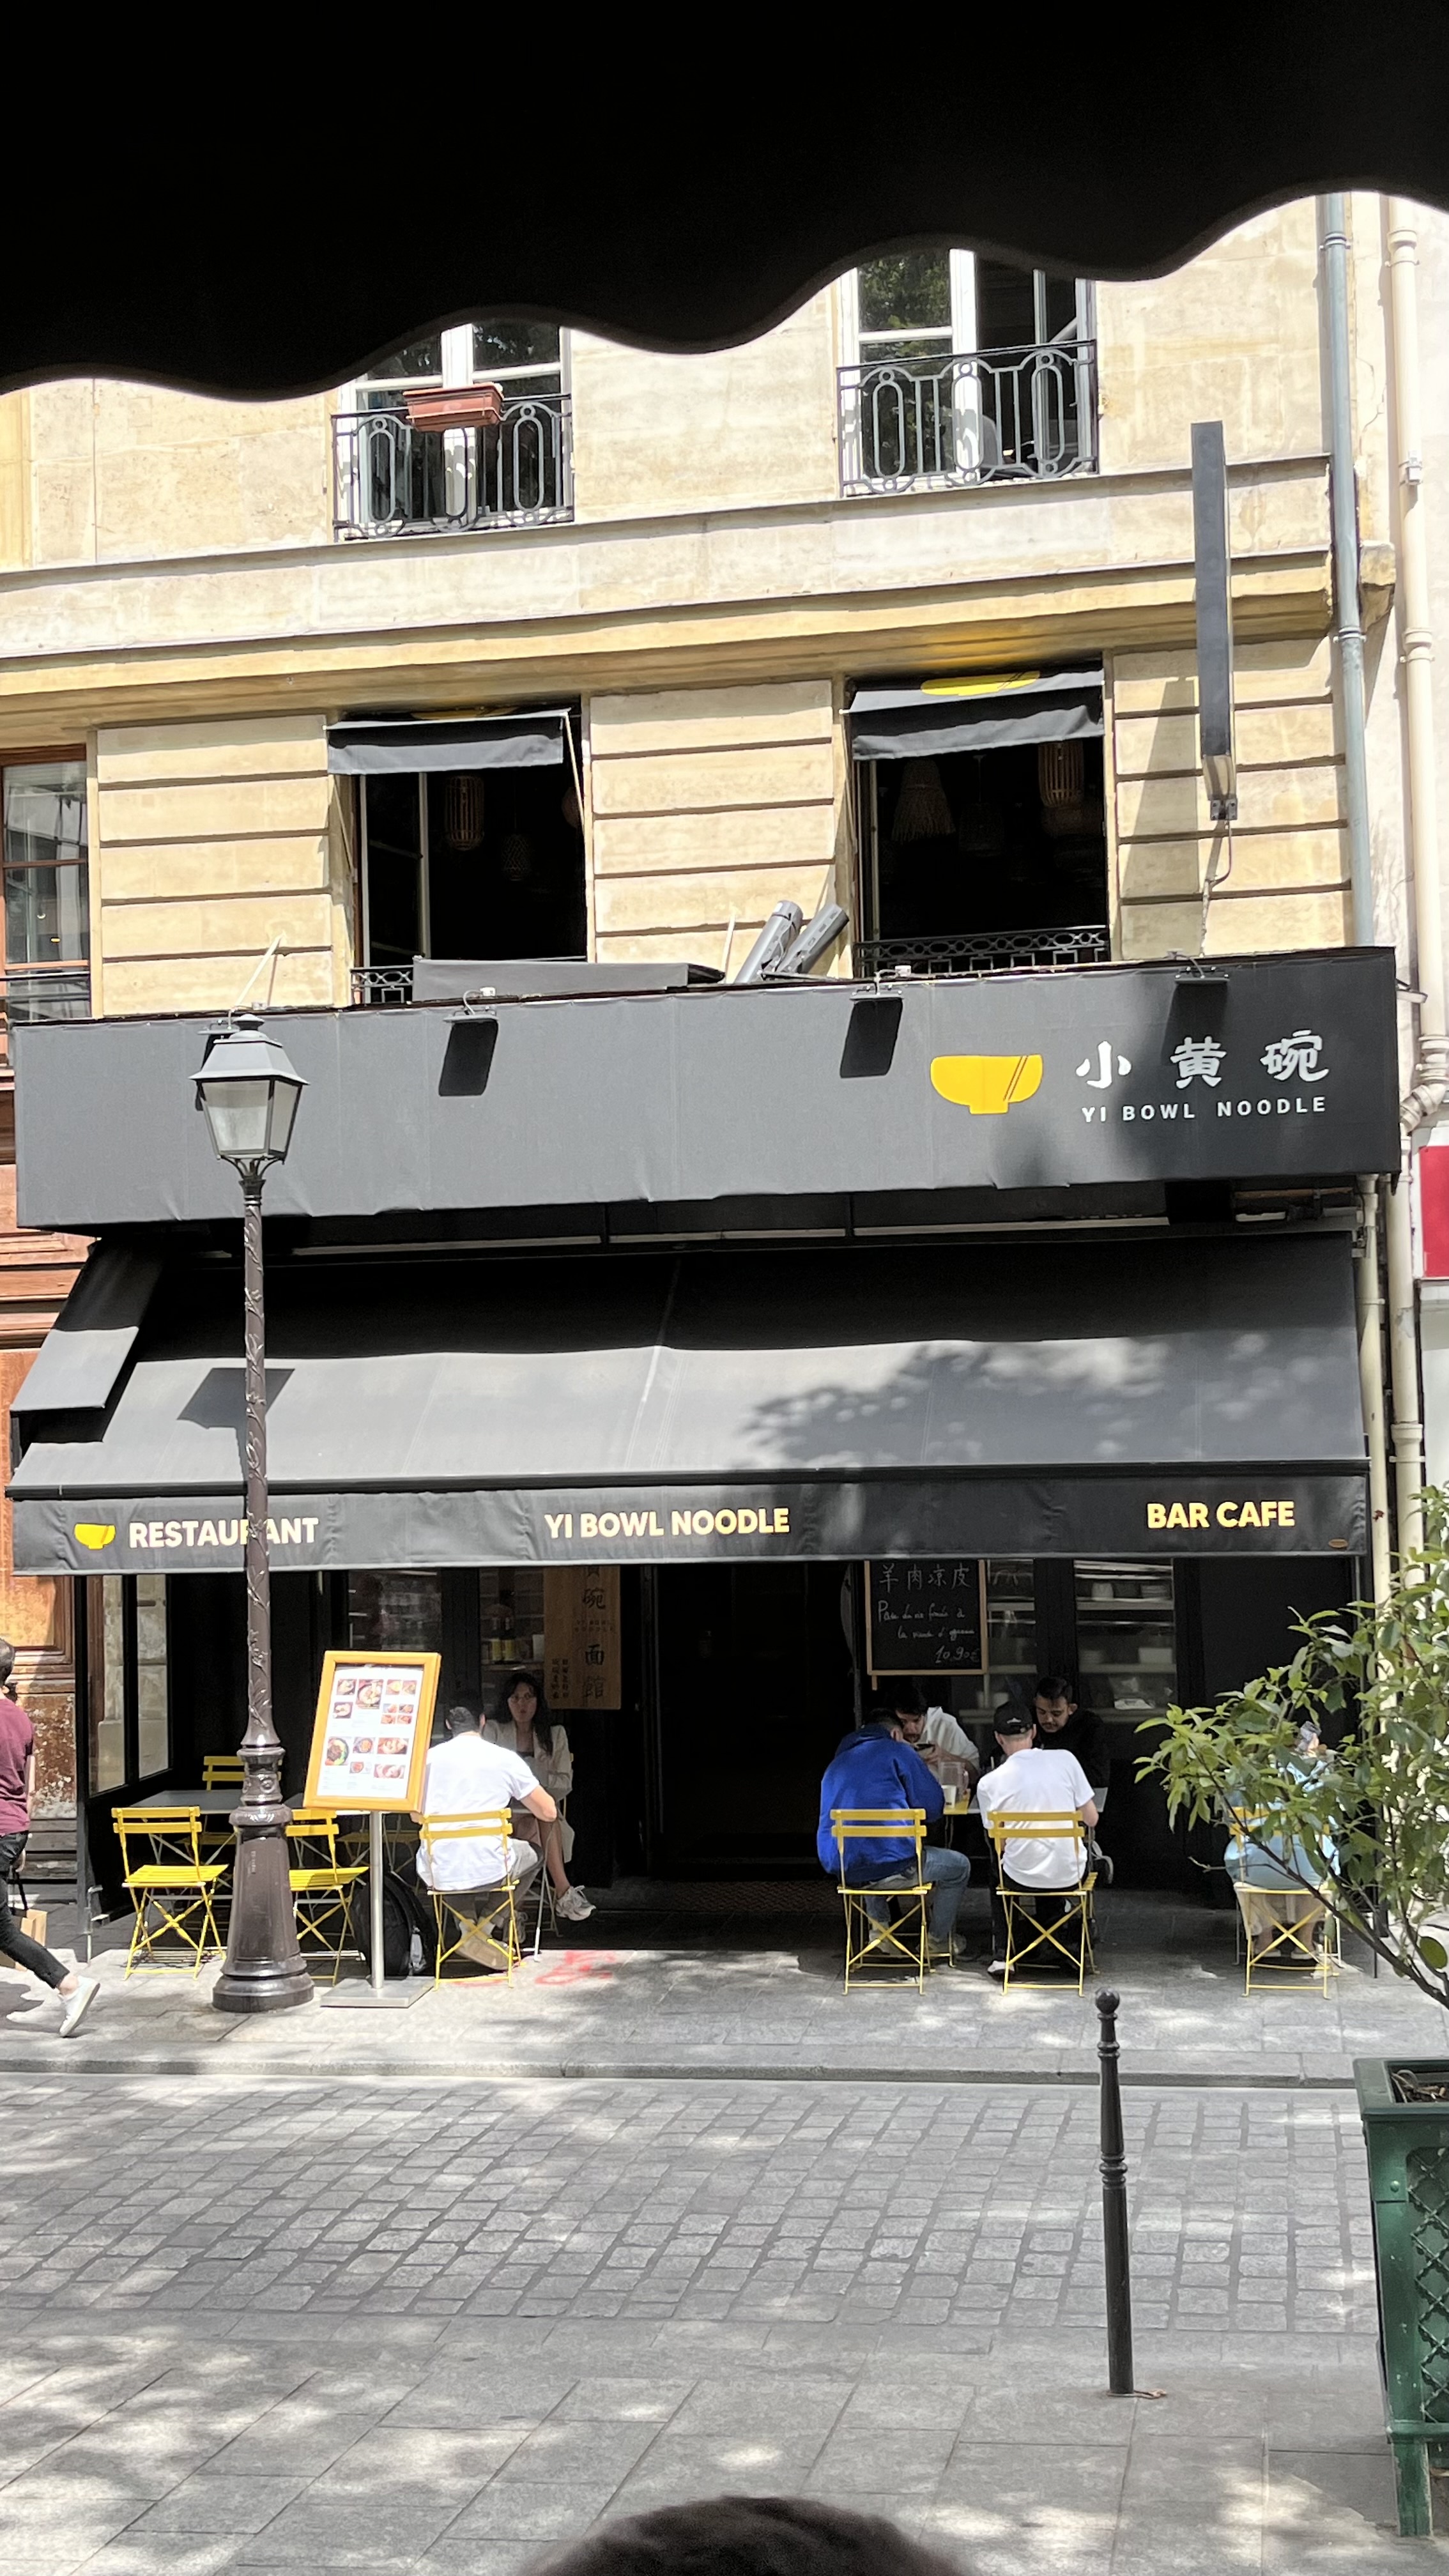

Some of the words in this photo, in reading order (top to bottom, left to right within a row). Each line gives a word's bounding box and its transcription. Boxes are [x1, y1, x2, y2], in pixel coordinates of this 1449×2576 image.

[1075, 1029, 1330, 1089] 小黄碗
[1082, 1106, 1107, 1123] YI
[1123, 1103, 1195, 1121] BOWL
[1216, 1096, 1326, 1117] NOODLE
[544, 1513, 572, 1538] YI
[580, 1511, 664, 1538] BOWL
[671, 1508, 790, 1536] NOODLE
[1147, 1502, 1210, 1529] BAR
[1216, 1501, 1295, 1528] CAFE
